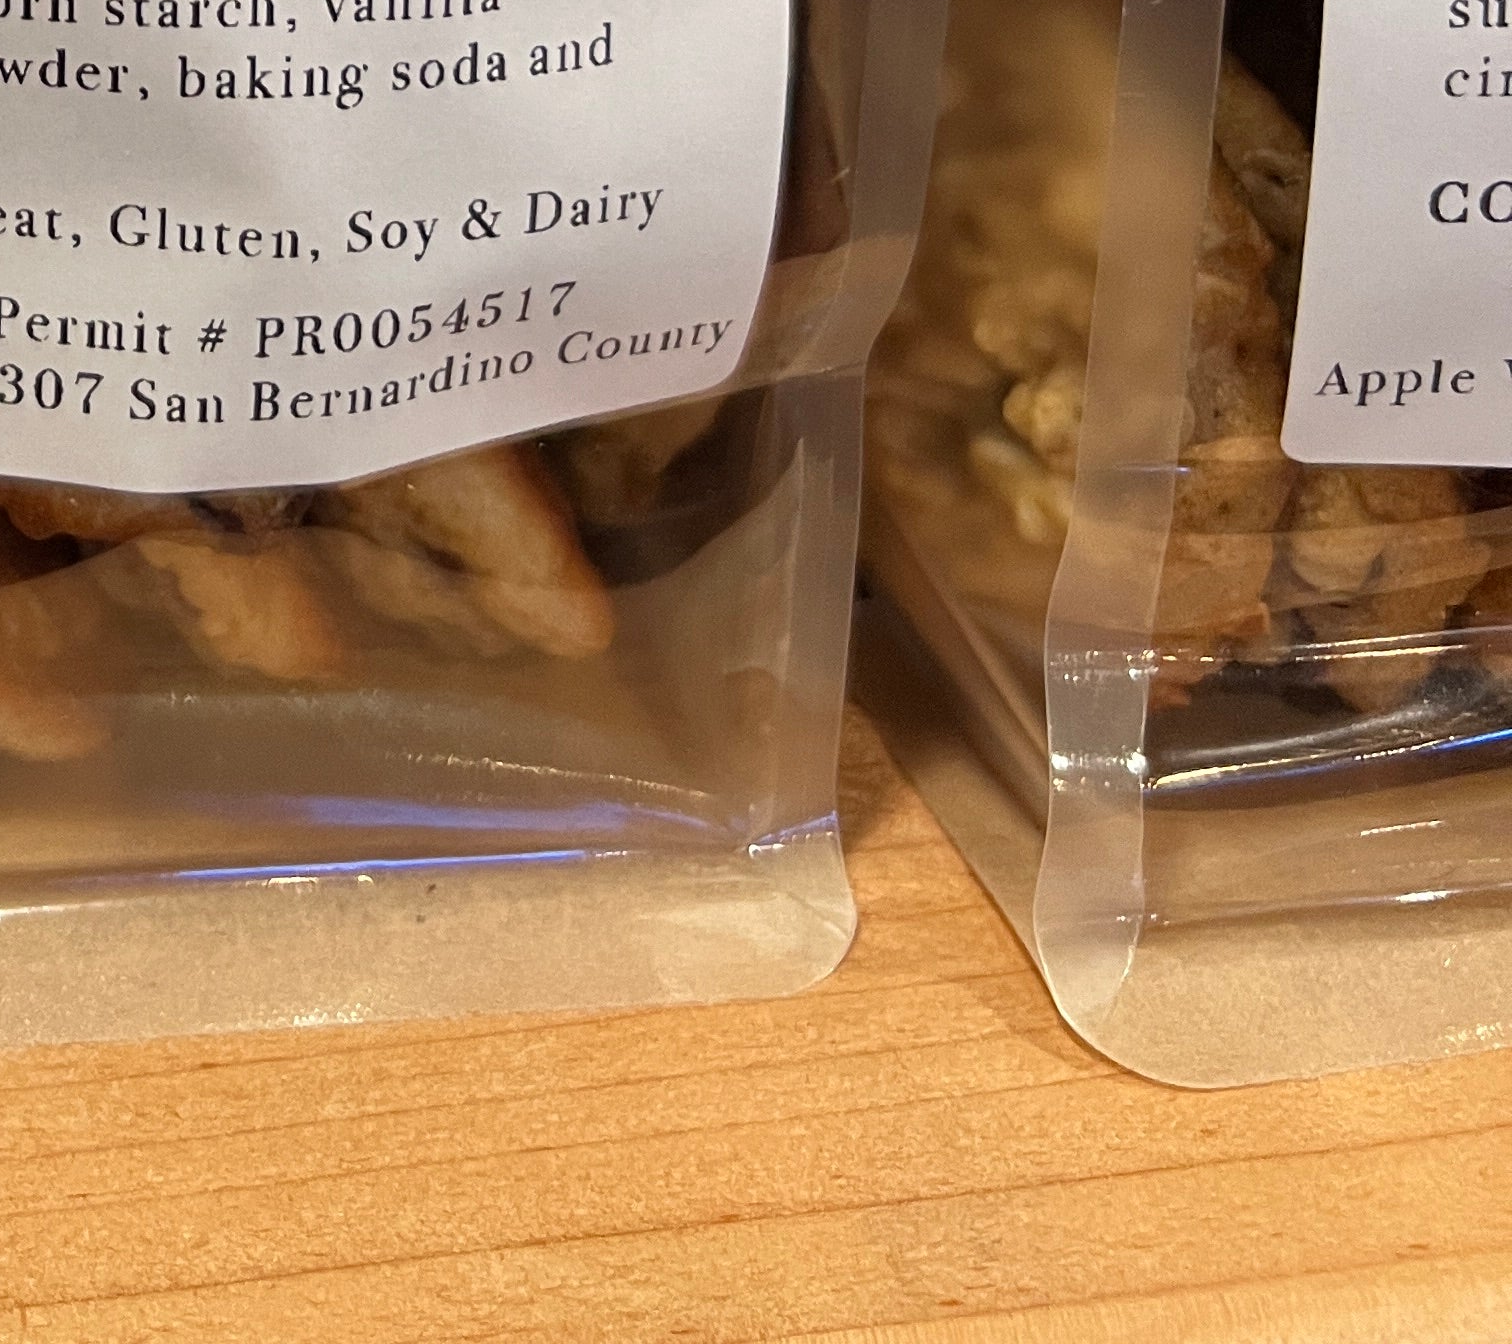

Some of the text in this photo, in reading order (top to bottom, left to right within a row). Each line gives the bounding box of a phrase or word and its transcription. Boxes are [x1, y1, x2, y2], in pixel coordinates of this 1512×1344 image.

[177, 54, 369, 111] baking
[391, 41, 507, 92] soda
[529, 21, 613, 77] and
[109, 203, 320, 264] Gluten,
[346, 210, 439, 262] Soy
[461, 198, 502, 242] &
[524, 184, 663, 235] Dairy
[129, 377, 224, 424] San
[250, 350, 534, 422] Bernardino
[557, 317, 734, 366] County
[197, 318, 228, 354] #
[1316, 358, 1476, 408] Apple
